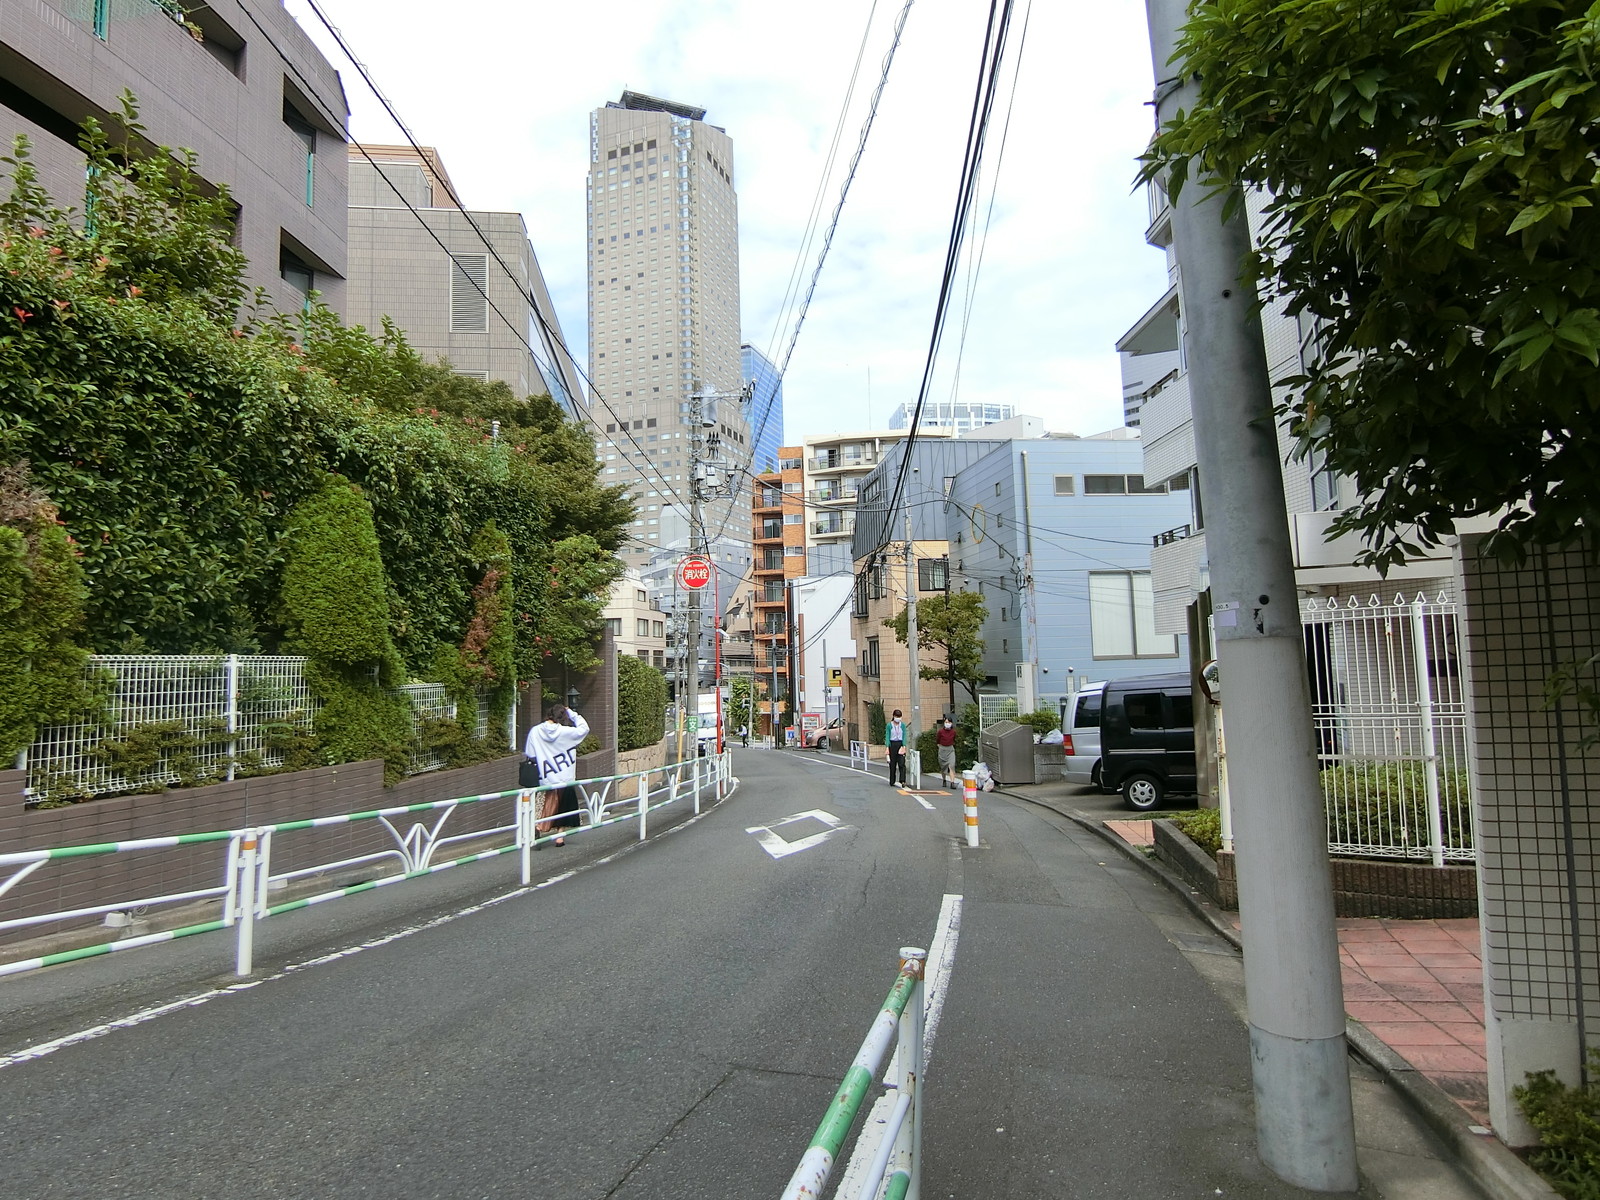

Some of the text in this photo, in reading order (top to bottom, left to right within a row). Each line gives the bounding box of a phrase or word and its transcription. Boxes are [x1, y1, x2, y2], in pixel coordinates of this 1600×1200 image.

[685, 568, 708, 580] 消火栓
[832, 669, 842, 679] P
[688, 721, 697, 730] 文
